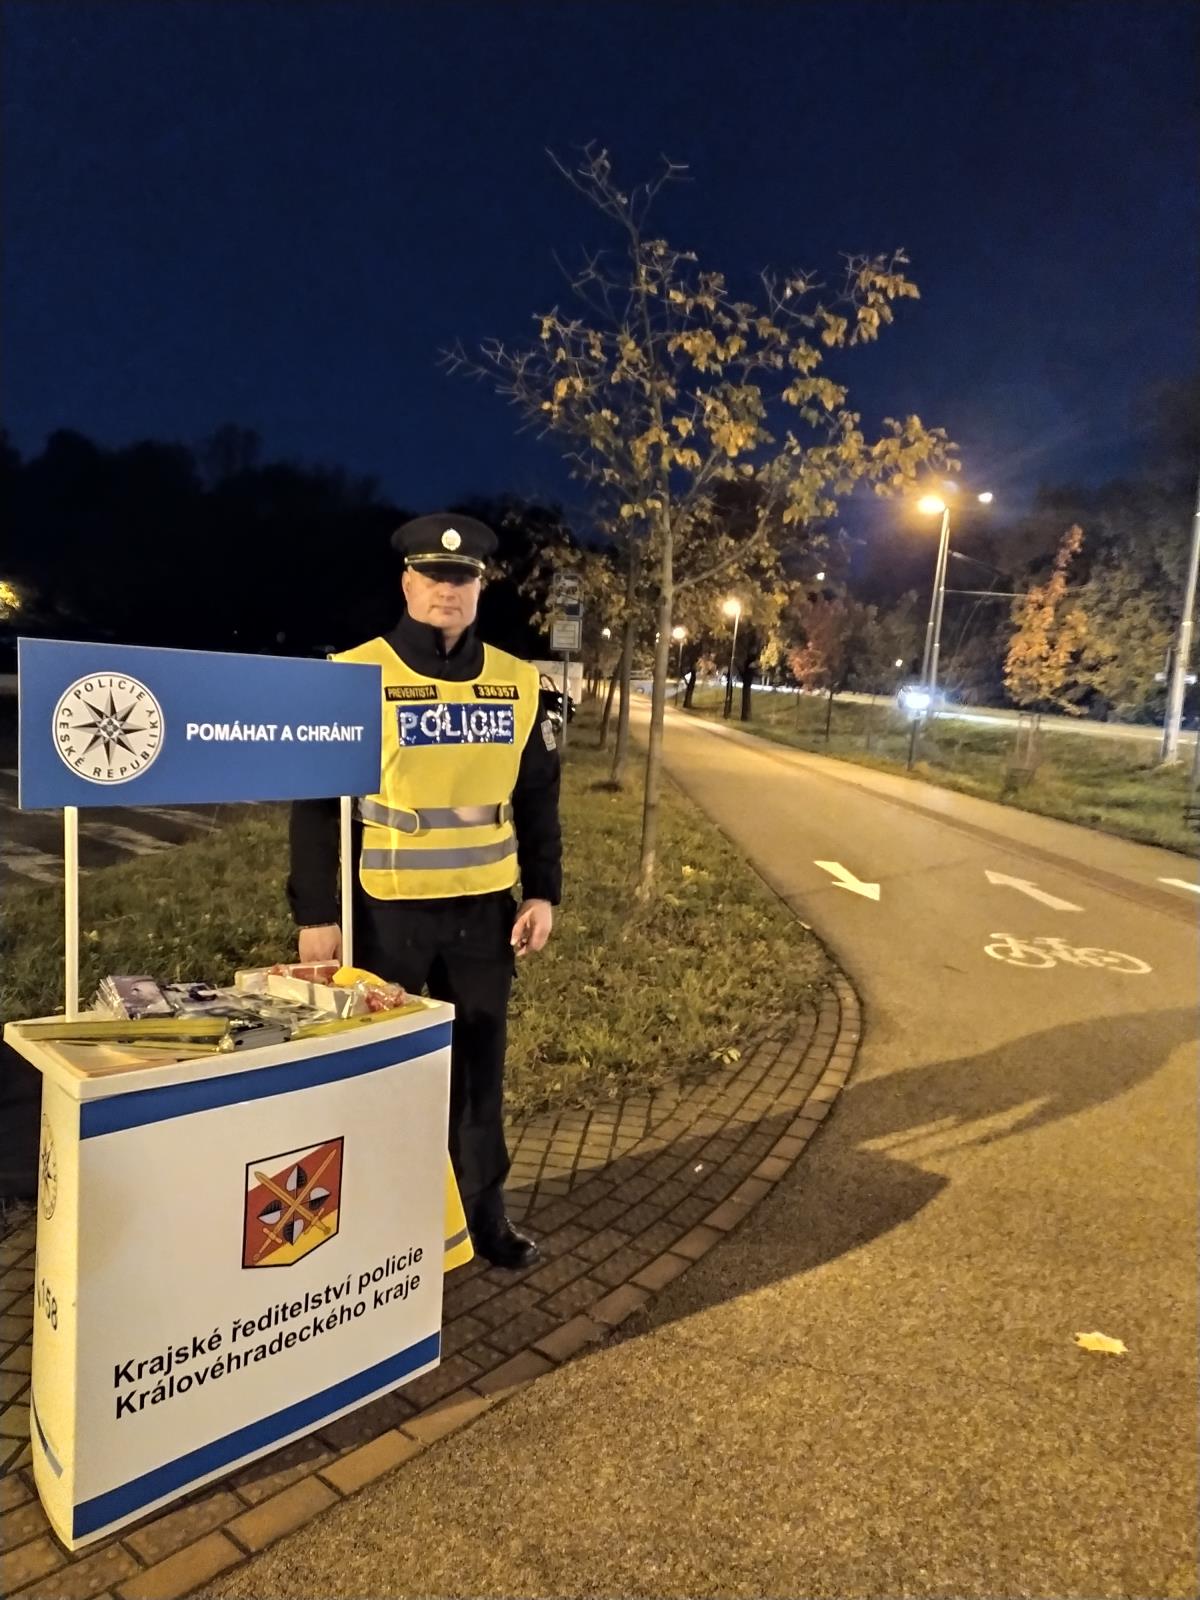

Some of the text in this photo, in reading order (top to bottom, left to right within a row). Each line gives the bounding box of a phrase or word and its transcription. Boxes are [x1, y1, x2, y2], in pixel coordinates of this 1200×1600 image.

[74, 678, 146, 700] POLICIE
[387, 687, 436, 699] PREVENTISTA
[186, 720, 364, 742] POMÁHAT A CHRÁNIT
[399, 708, 512, 738] POLICIE
[93, 709, 159, 778] REPUBLIKY
[113, 1246, 423, 1388] Krajské ředitelství policie
[115, 1273, 421, 1419] Královéhradeckého kraje
